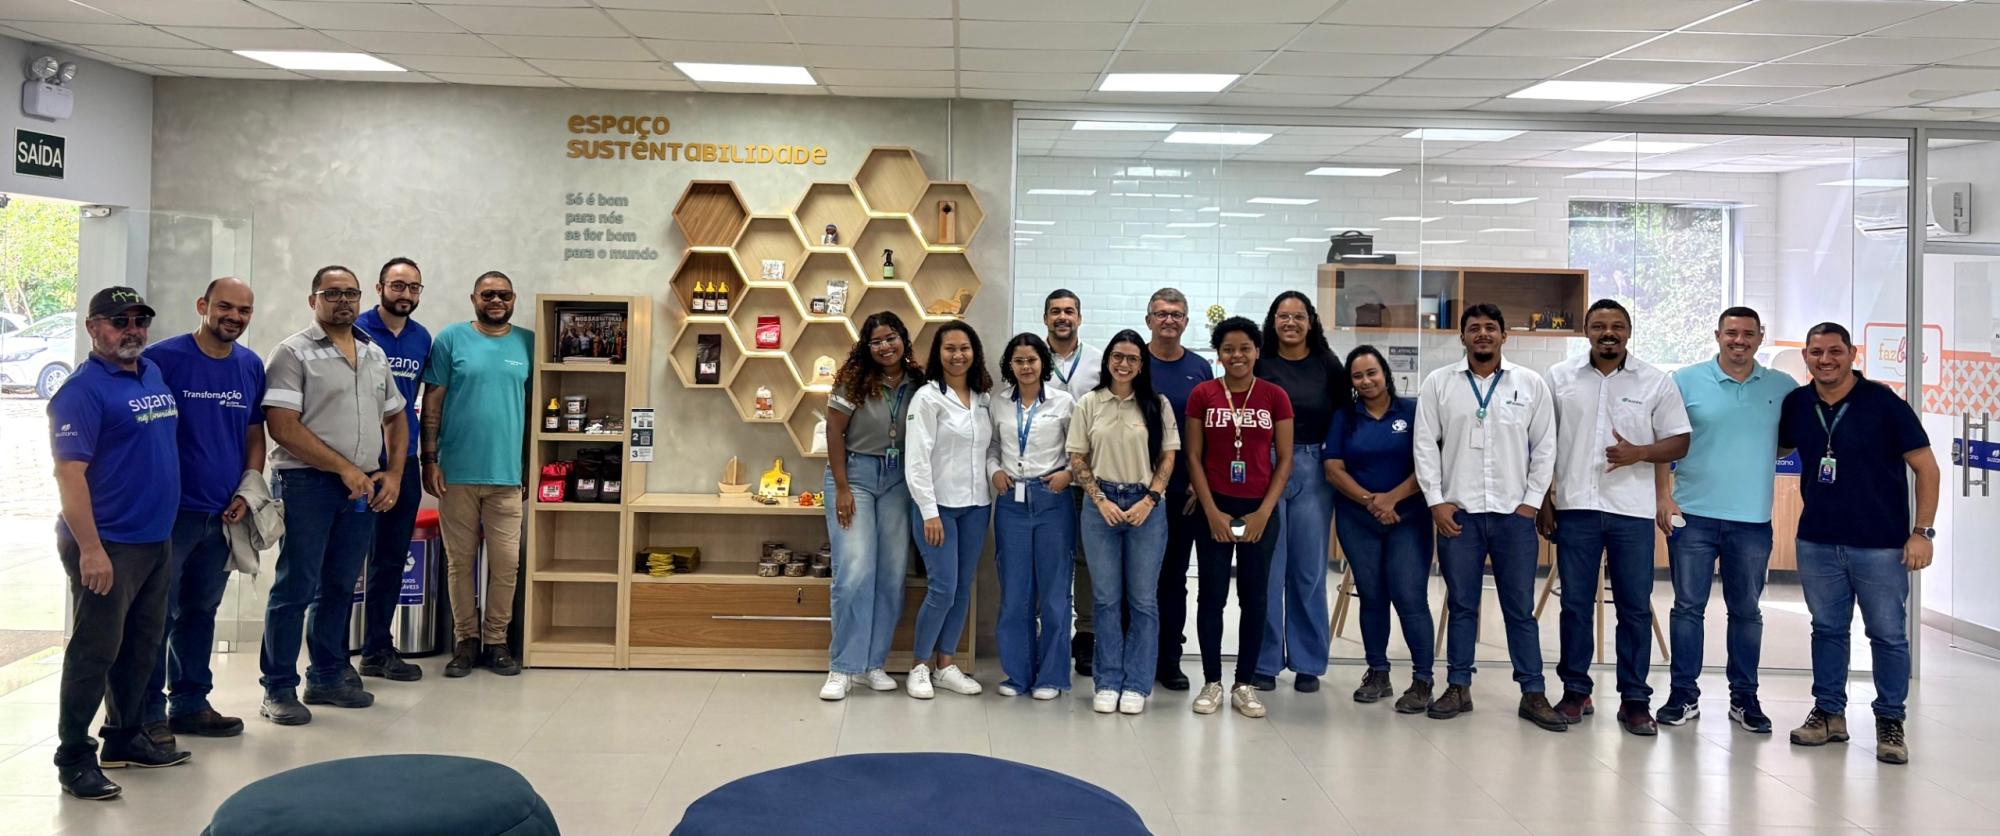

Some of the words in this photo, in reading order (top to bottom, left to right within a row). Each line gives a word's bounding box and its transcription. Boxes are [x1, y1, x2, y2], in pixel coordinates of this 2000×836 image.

[17, 139, 63, 168] SAÍDA
[565, 192, 584, 206] Só
[586, 192, 596, 206] é
[598, 193, 629, 207] bom
[565, 212, 595, 226] para
[598, 211, 624, 224] nós
[564, 231, 581, 241] se
[583, 228, 604, 241] for
[606, 229, 637, 242] bom
[564, 248, 595, 261] para
[597, 249, 607, 259] o
[609, 247, 658, 260] mundo
[388, 357, 420, 370] zano
[128, 394, 177, 412] suzano
[1205, 408, 1273, 430] IFES
[632, 433, 639, 441] 2
[632, 450, 639, 458] 3
